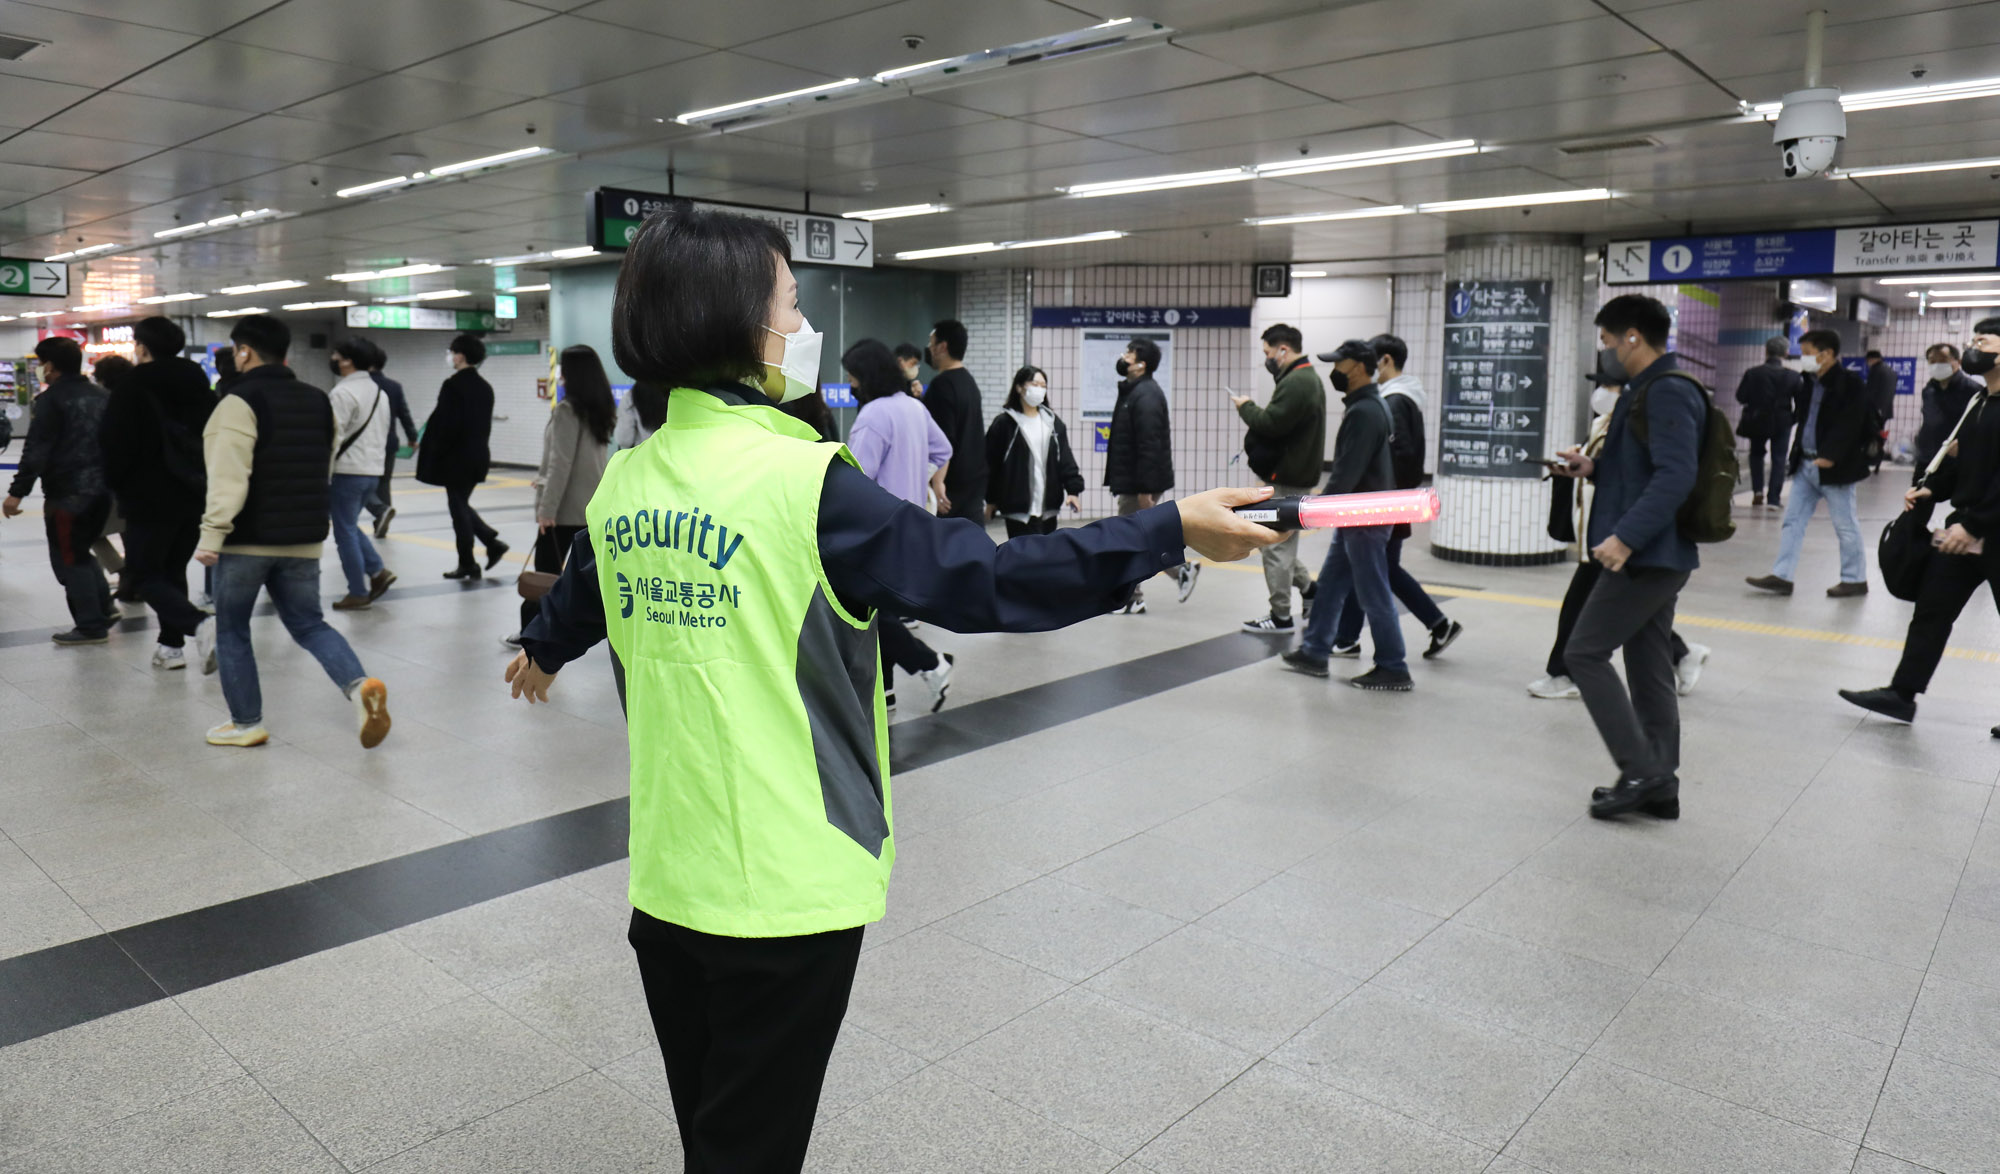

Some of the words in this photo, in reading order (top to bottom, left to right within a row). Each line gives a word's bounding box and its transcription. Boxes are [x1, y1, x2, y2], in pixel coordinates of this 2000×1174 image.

[1859, 227, 1944, 252] 갈아타는
[1952, 225, 1975, 248] 곳
[1855, 254, 1900, 266] Transfer
[4, 268, 17, 284] 2
[1510, 287, 1527, 307] 곳
[1105, 310, 1147, 324] 갈아타는
[1150, 310, 1160, 323] 곳
[605, 507, 744, 570] security
[635, 577, 741, 608] 서울교통공사
[646, 606, 675, 625] Seoul
[679, 611, 727, 628] Metro
